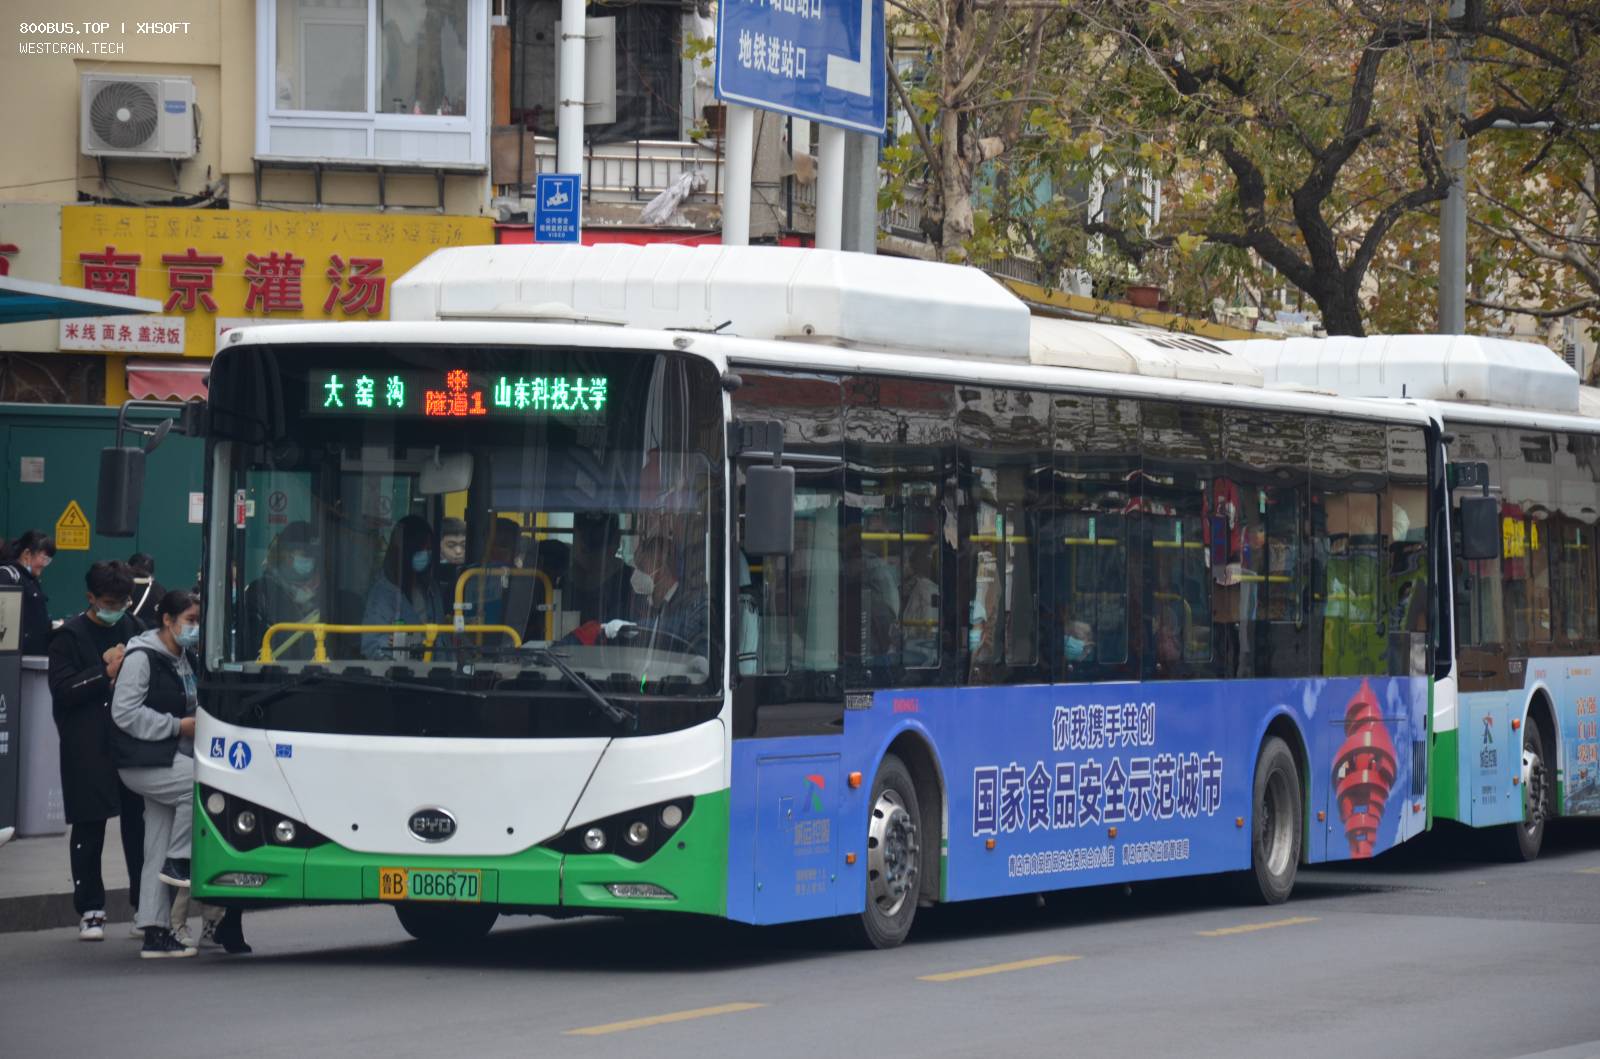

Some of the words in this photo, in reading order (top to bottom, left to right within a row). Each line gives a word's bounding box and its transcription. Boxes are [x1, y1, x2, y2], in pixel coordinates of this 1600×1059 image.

[738, 28, 807, 80] 地铁进站口
[79, 245, 387, 314] 南京灌汤
[64, 323, 97, 341] 米线
[102, 323, 133, 343] 面条
[137, 325, 181, 346] 盖浇饭
[323, 374, 405, 408] 大窑沟
[494, 376, 608, 411] 山东科技大学
[1052, 702, 1156, 751] 你我携手共创
[972, 751, 1223, 838] 国家食品安全示范城市
[413, 816, 451, 833] BYD
